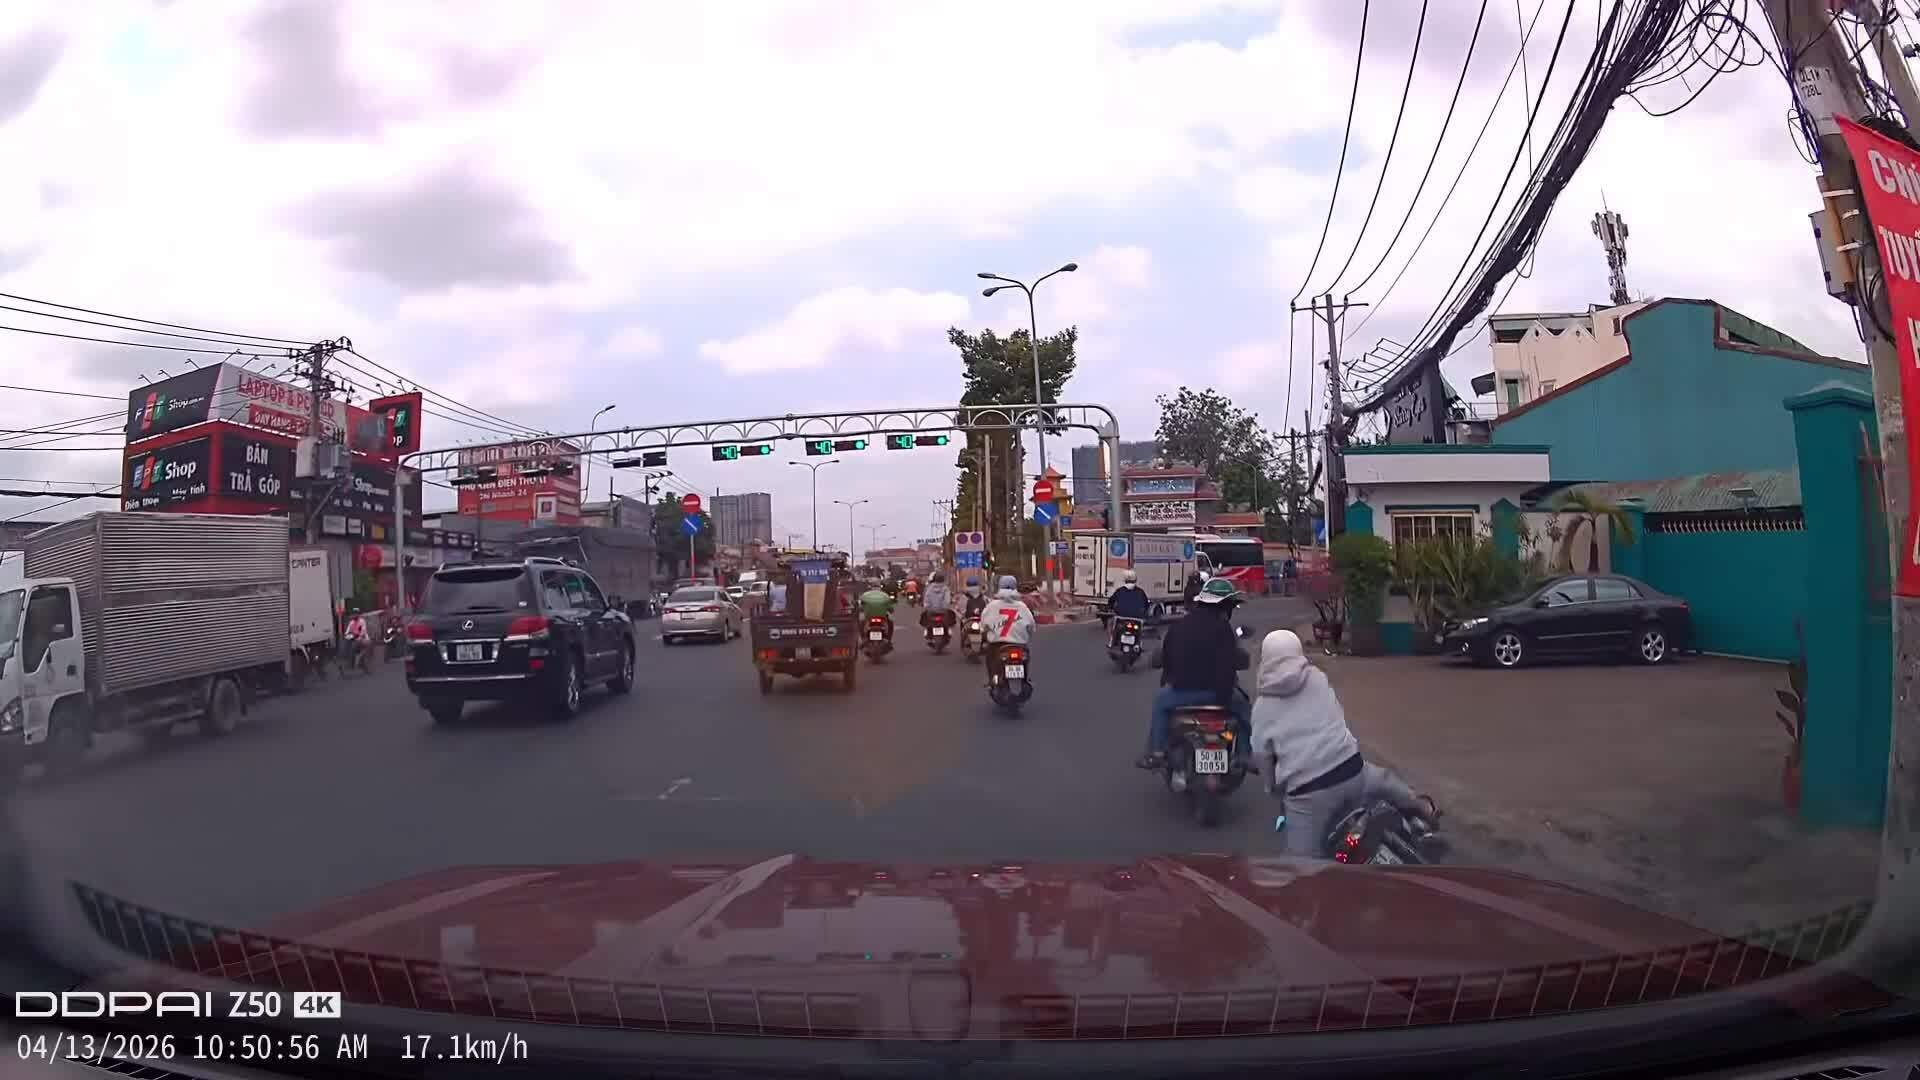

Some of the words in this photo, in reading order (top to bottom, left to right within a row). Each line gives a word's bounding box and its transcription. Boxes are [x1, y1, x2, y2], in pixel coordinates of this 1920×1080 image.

[1878, 224, 1920, 284] TUY
[246, 443, 269, 465] BÁN
[133, 459, 164, 487] FPT
[165, 461, 196, 480] Shop
[258, 473, 281, 496] GÓP
[999, 608, 1018, 637] 7
